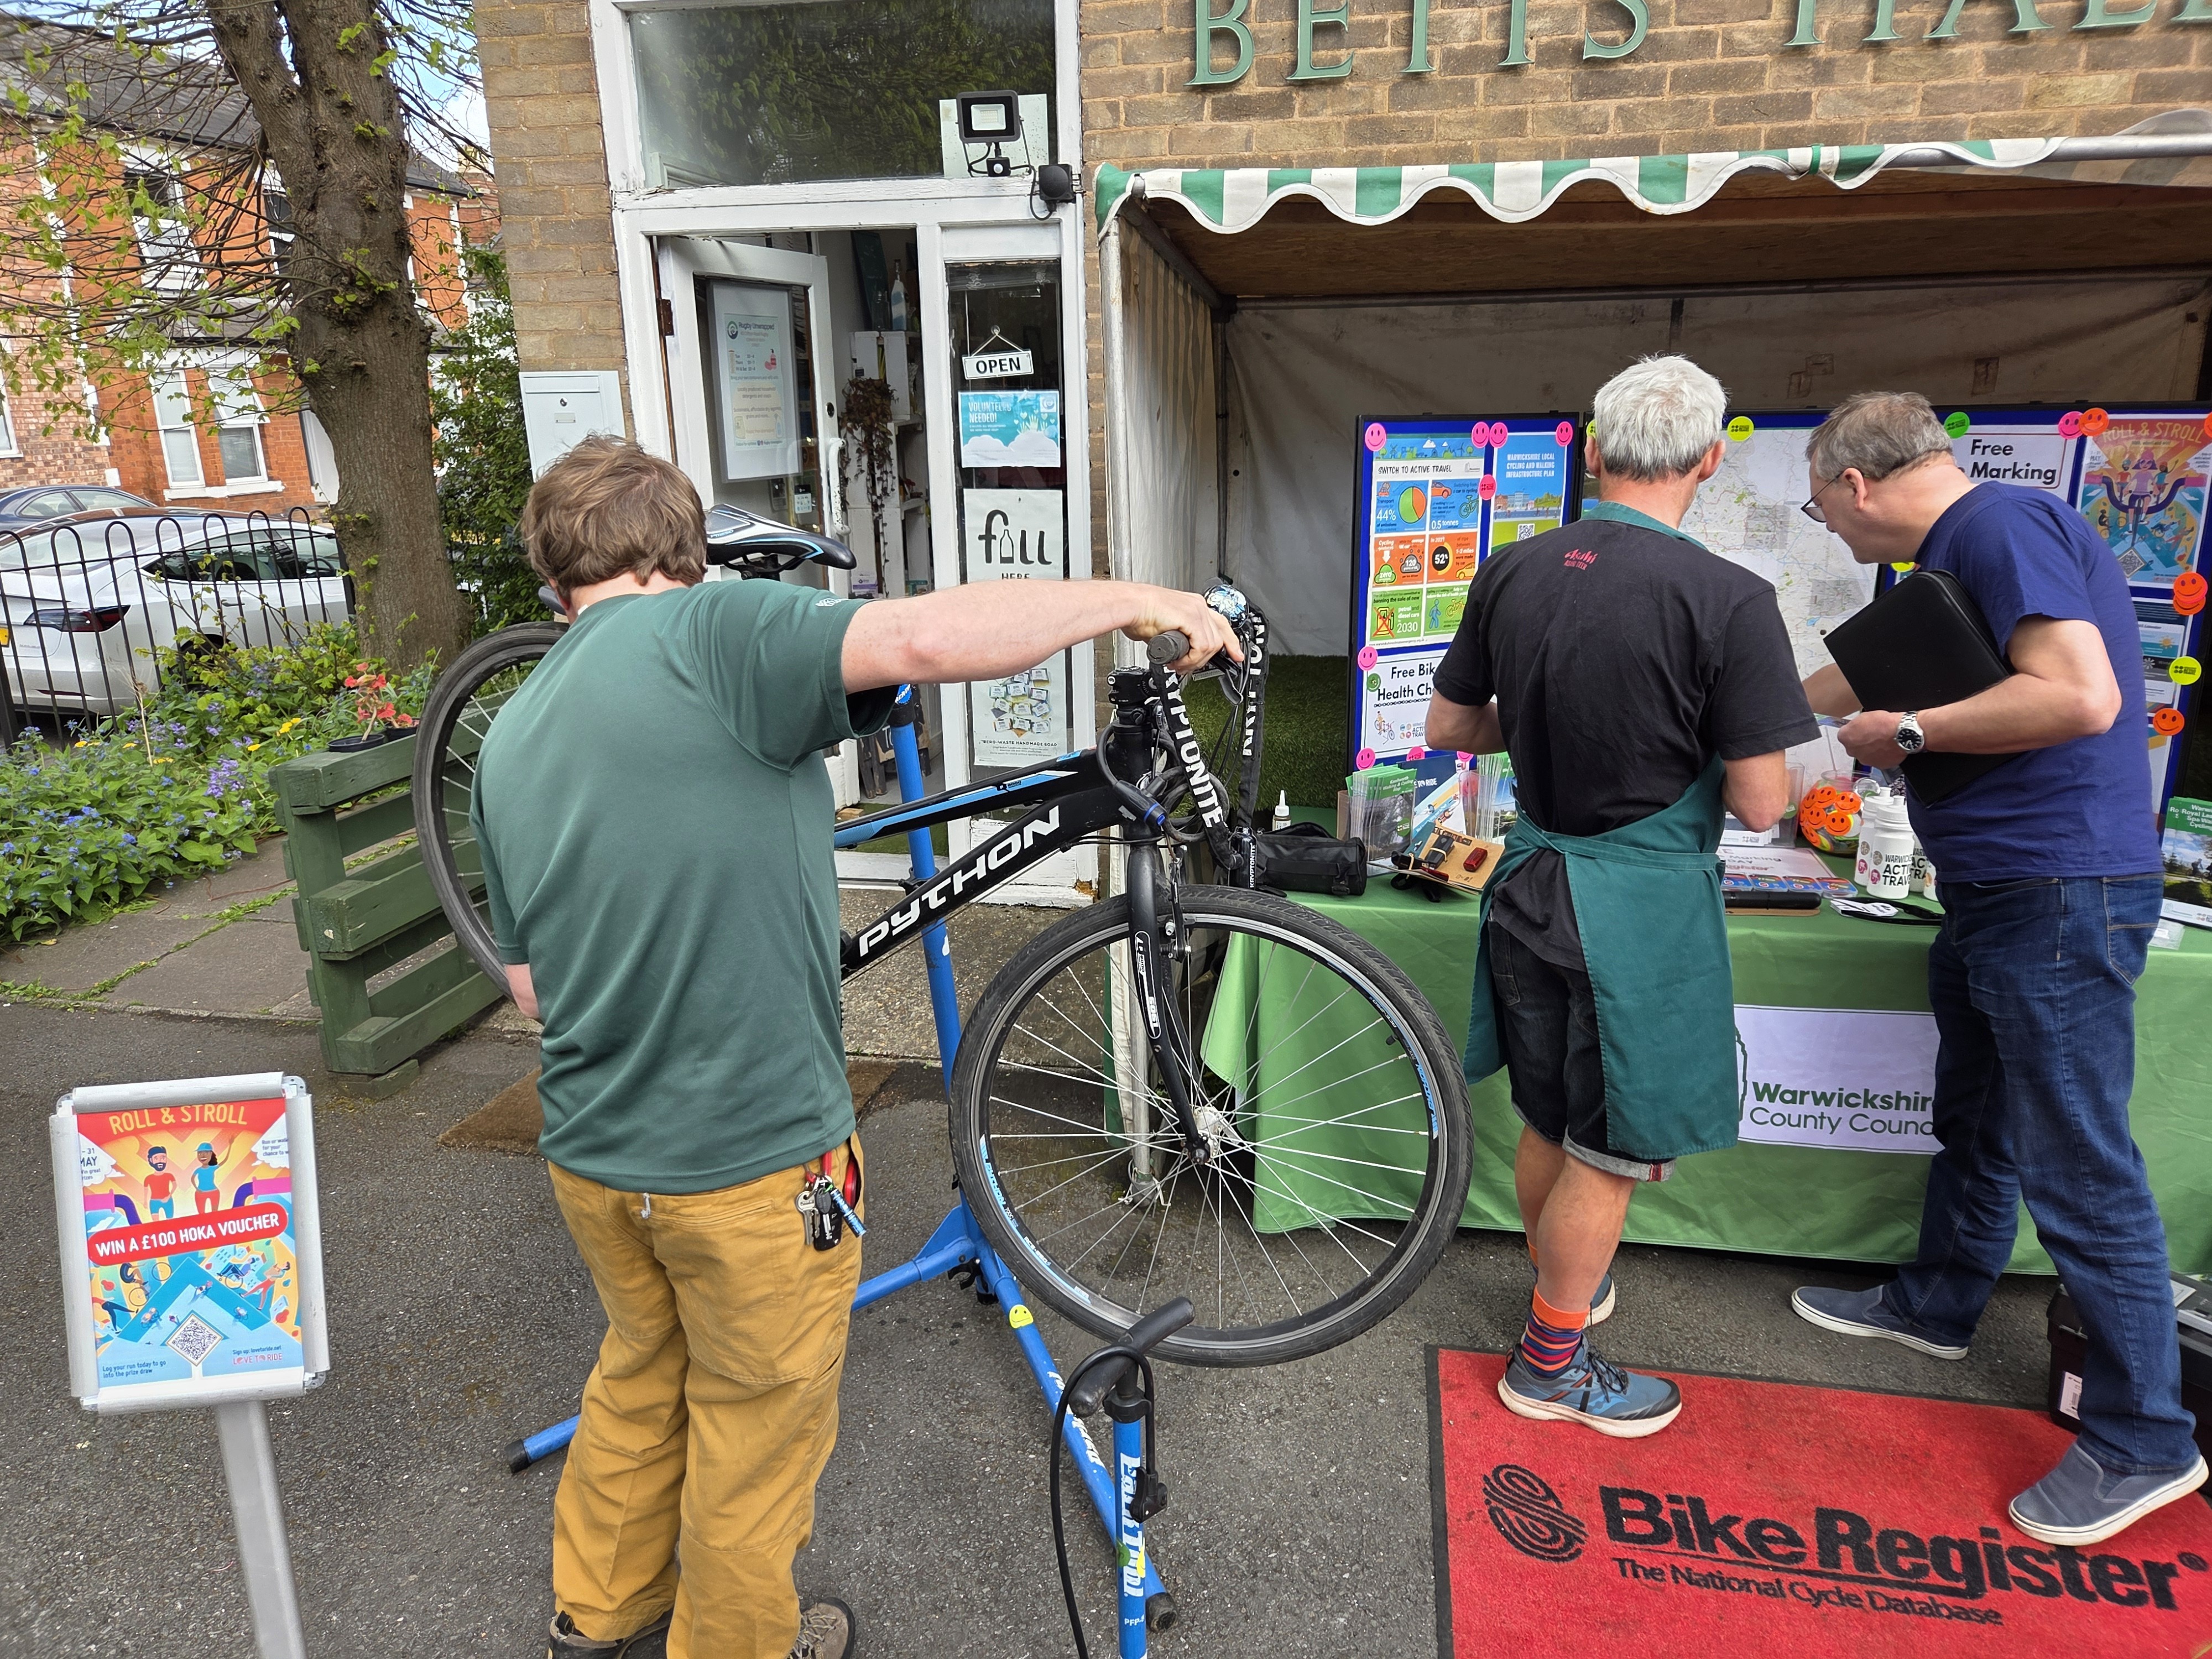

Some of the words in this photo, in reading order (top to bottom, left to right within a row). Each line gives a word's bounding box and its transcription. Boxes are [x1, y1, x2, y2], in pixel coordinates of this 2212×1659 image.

[976, 357, 1021, 374] OPEN
[969, 413, 997, 423] NEEDED!
[2103, 424, 2135, 442] ROLL
[2138, 422, 2150, 436] &
[2156, 422, 2204, 444] STROLL
[1971, 439, 2013, 456] Free
[1378, 466, 1399, 474] SWITCH
[1401, 466, 1408, 474] TO
[1410, 465, 1431, 473] ACTIVE
[1432, 465, 1452, 473] TRAVEL
[1970, 462, 2057, 485] Marking
[1376, 509, 1396, 521] 44%
[1432, 520, 1441, 529] 0.5
[1434, 553, 1448, 565] 52%
[1564, 549, 1598, 564] Asahi
[1397, 622, 1418, 633] 2030
[1391, 666, 1415, 679] Free
[1378, 685, 1413, 701] Health
[1417, 682, 1432, 696] Ch
[1426, 778, 1437, 786] RIDE
[2182, 808, 2200, 817] Royal
[859, 805, 1060, 957] PYTHON
[109, 1109, 156, 1135] ROLL
[161, 1107, 176, 1124] &
[181, 1104, 247, 1125] STROLL
[1750, 1107, 1842, 1135] County
[986, 1162, 1006, 1206] PYTHON
[1005, 1207, 1014, 1220] 700C
[95, 1239, 126, 1257] WIN
[129, 1237, 139, 1253] A
[142, 1231, 176, 1249] £100
[179, 1225, 216, 1243] HOKA
[218, 1213, 279, 1236] VOUCHER
[233, 1355, 253, 1365] LOVE
[1612, 1557, 1666, 1580] The
[1670, 1564, 1787, 1598] National
[1789, 1581, 1864, 1608] Cycle
[1865, 1588, 2005, 1626] Database
